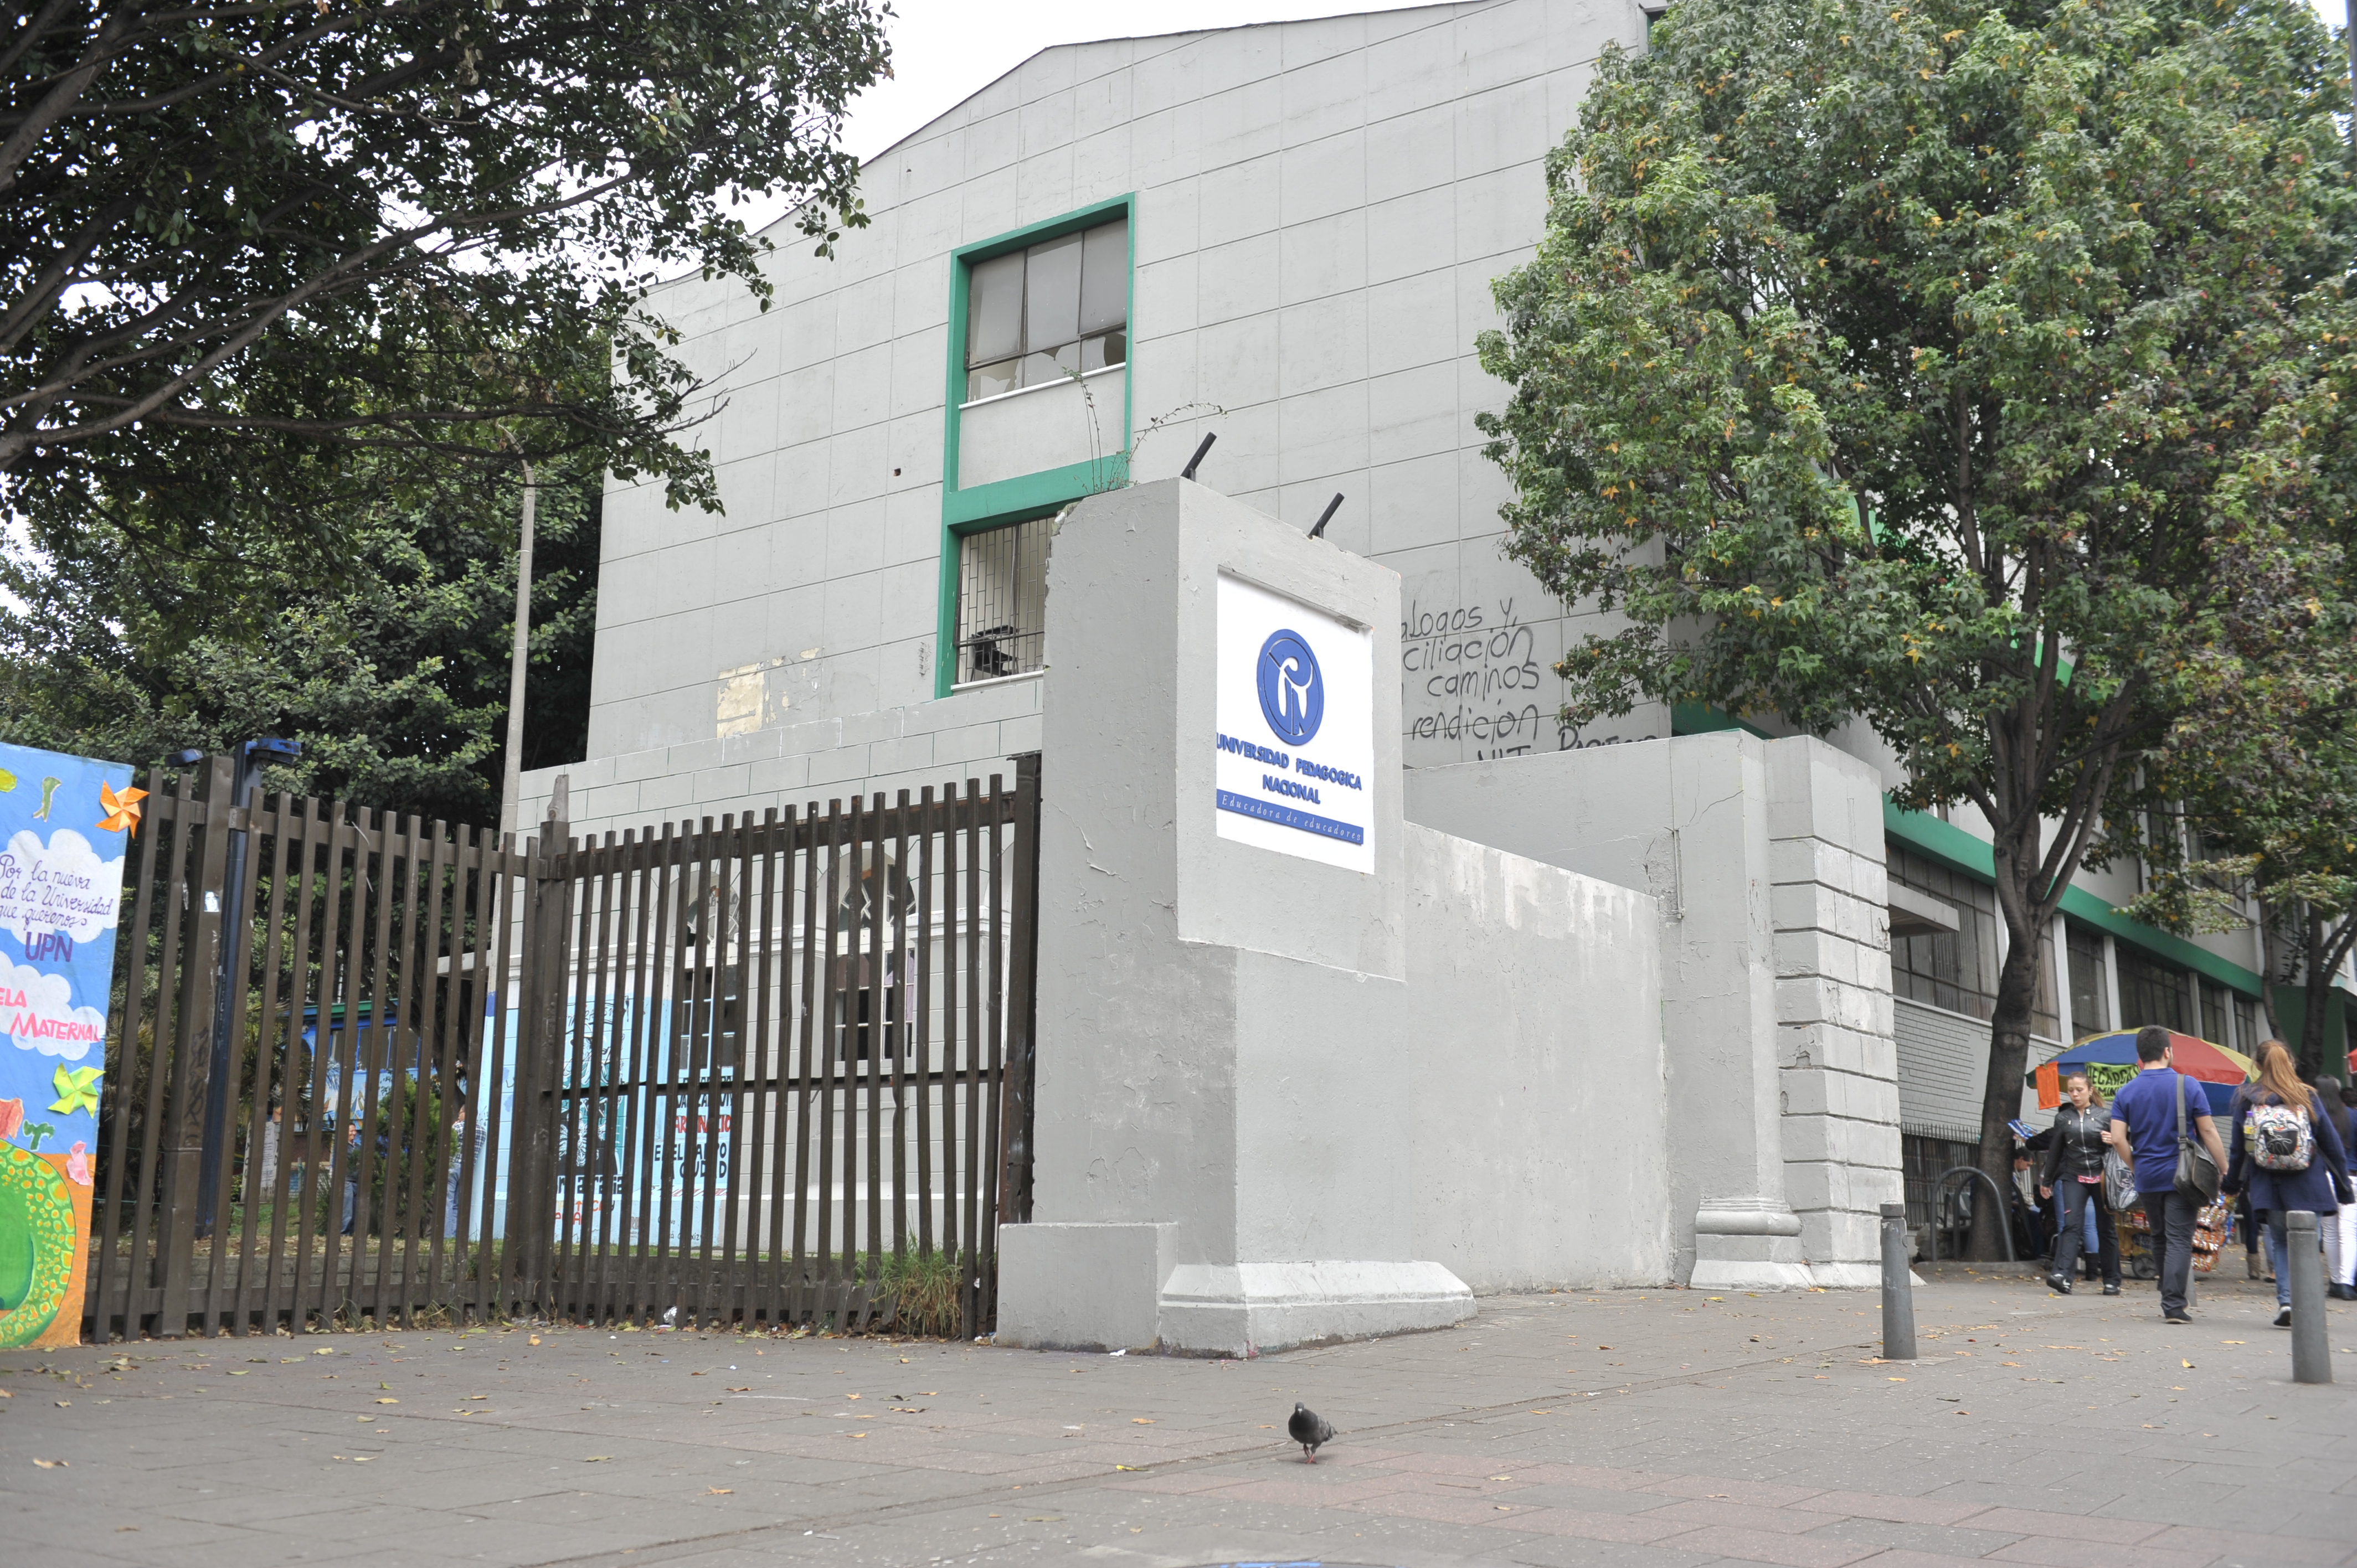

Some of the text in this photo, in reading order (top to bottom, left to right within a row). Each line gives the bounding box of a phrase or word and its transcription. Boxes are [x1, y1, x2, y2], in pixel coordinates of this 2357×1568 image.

[1427, 662, 1540, 702] caminos
[1217, 732, 1362, 791] UNIVERSIDAD PEDAGOGICA
[1262, 774, 1321, 804] NACIONAL
[1222, 795, 1361, 841] Educadora de educadores
[0, 854, 91, 890] Por la nueva
[1, 879, 113, 915] de la Universidad
[25, 932, 73, 962] UPN
[9, 1012, 101, 1041] MATERNAL
